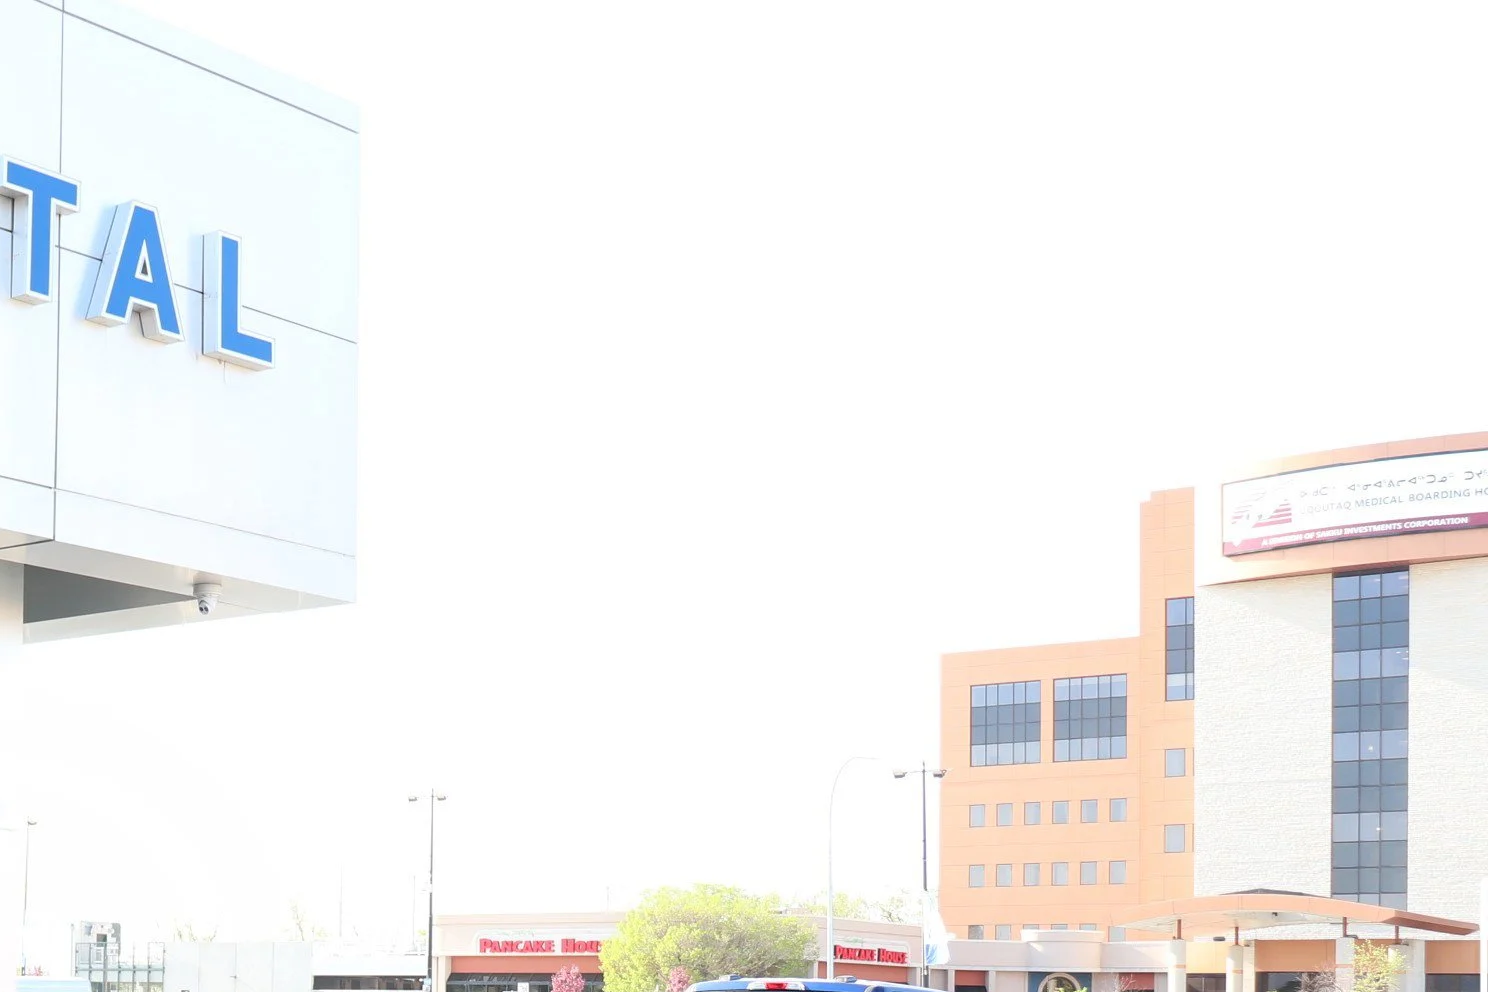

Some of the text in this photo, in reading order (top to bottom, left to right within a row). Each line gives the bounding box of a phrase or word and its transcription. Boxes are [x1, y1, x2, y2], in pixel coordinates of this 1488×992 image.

[1354, 495, 1404, 508] MEDICAL
[1408, 488, 1471, 502] BOARDING
[1304, 531, 1315, 540] OF
[1343, 522, 1403, 537] INVESTMENTS
[1403, 516, 1469, 530] CORPORATION
[479, 938, 555, 953] PANCAKE
[834, 944, 908, 964] PANCAKE HOUSE
